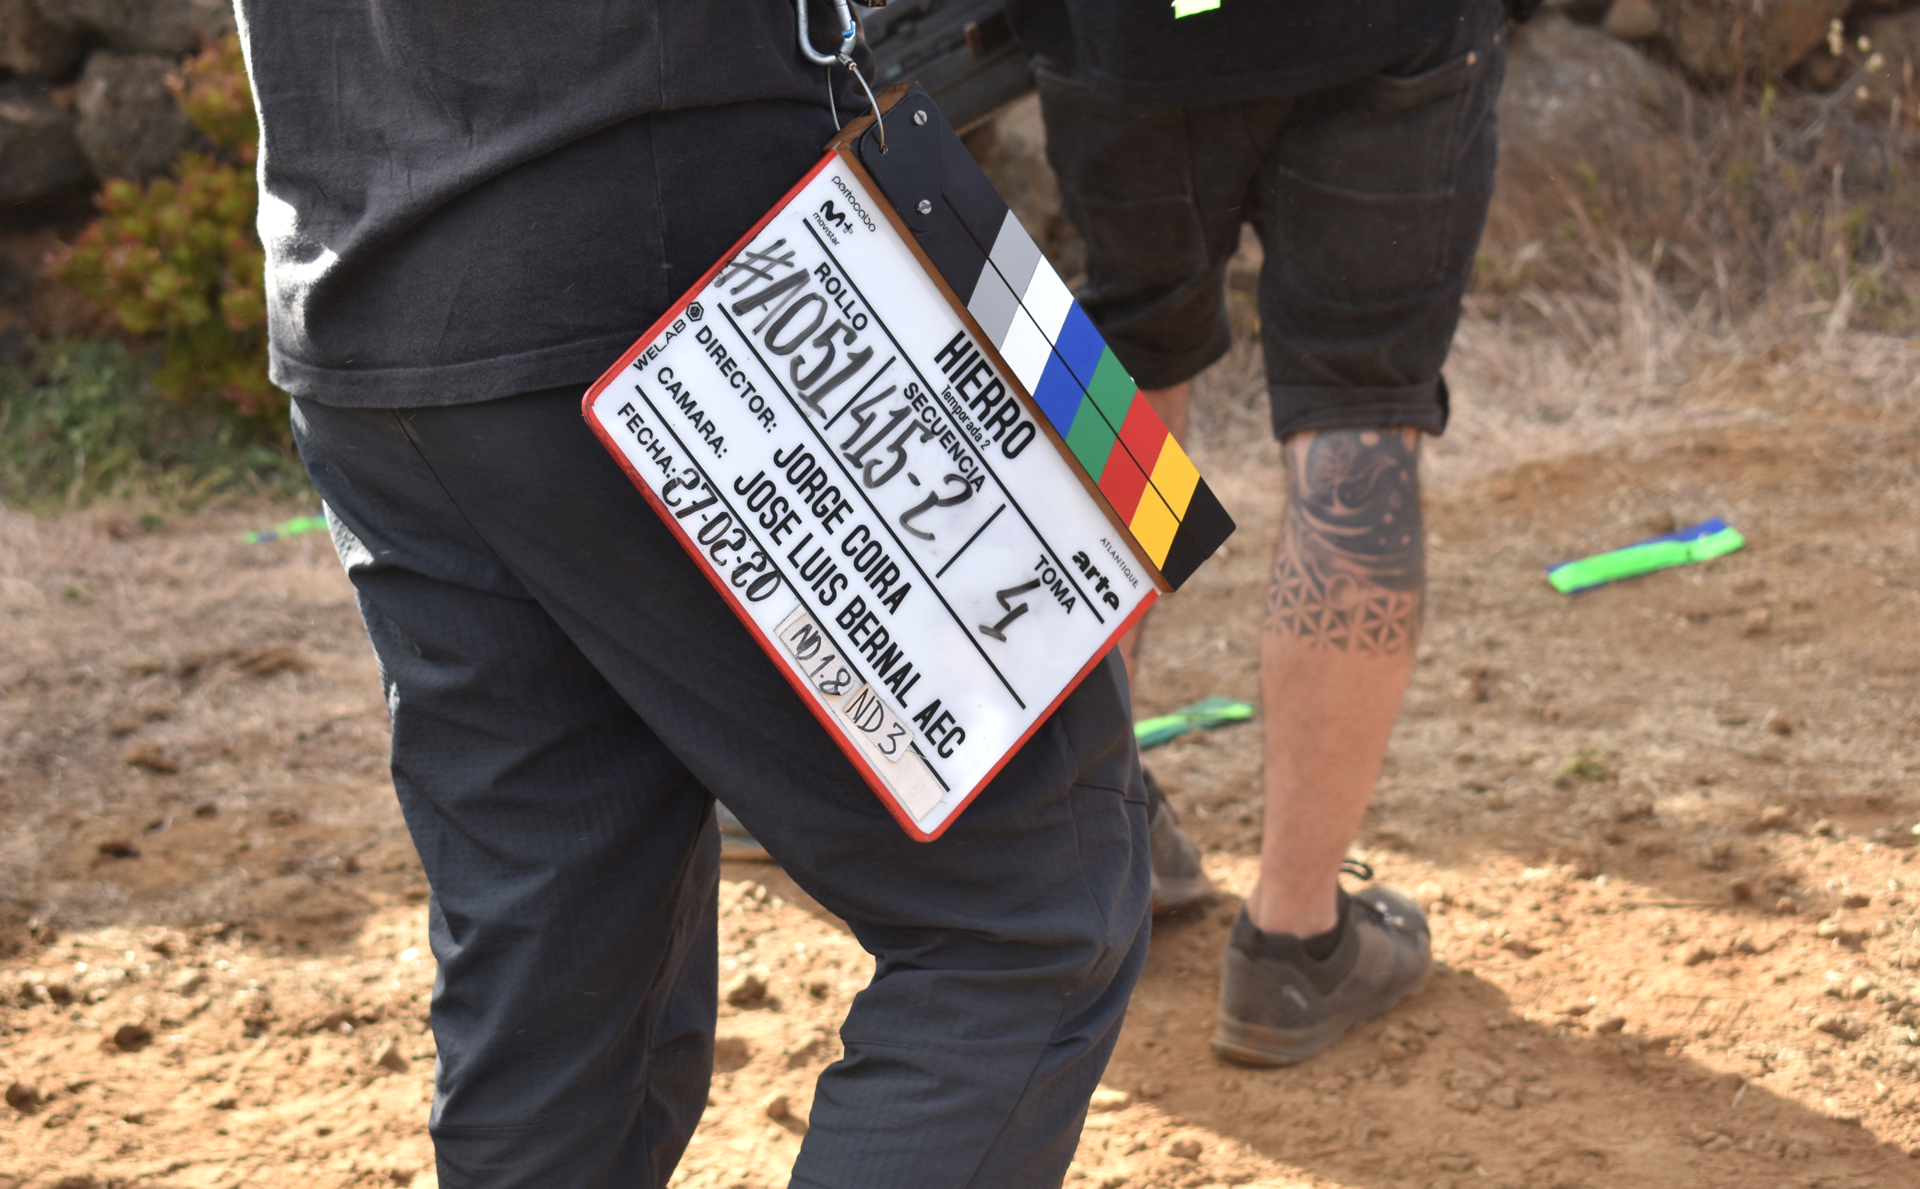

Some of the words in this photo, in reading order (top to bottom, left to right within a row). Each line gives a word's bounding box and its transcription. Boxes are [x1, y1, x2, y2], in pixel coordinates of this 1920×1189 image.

[813, 213, 839, 245] movistar
[814, 262, 868, 331] ROLLO
[633, 319, 686, 371] WELAB
[934, 330, 1036, 459] HIERRO
[936, 385, 982, 442] Temporada
[980, 440, 990, 450] 2
[618, 402, 676, 478] FECHA:
[904, 382, 985, 492] SECUENCIA
[695, 325, 776, 433] DIRECTOR:
[774, 443, 854, 535] JORGE
[841, 525, 911, 615] COIRA
[658, 367, 727, 458] CAMARA:
[734, 471, 802, 546] JOSE
[787, 533, 848, 606] LUIS
[835, 595, 921, 709] BERNAL
[912, 699, 965, 758] AEC
[1035, 554, 1076, 614] TOMA
[1072, 551, 1119, 610] arte
[1100, 538, 1138, 588] ATLANTIQUE
[979, 578, 1041, 642] 4
